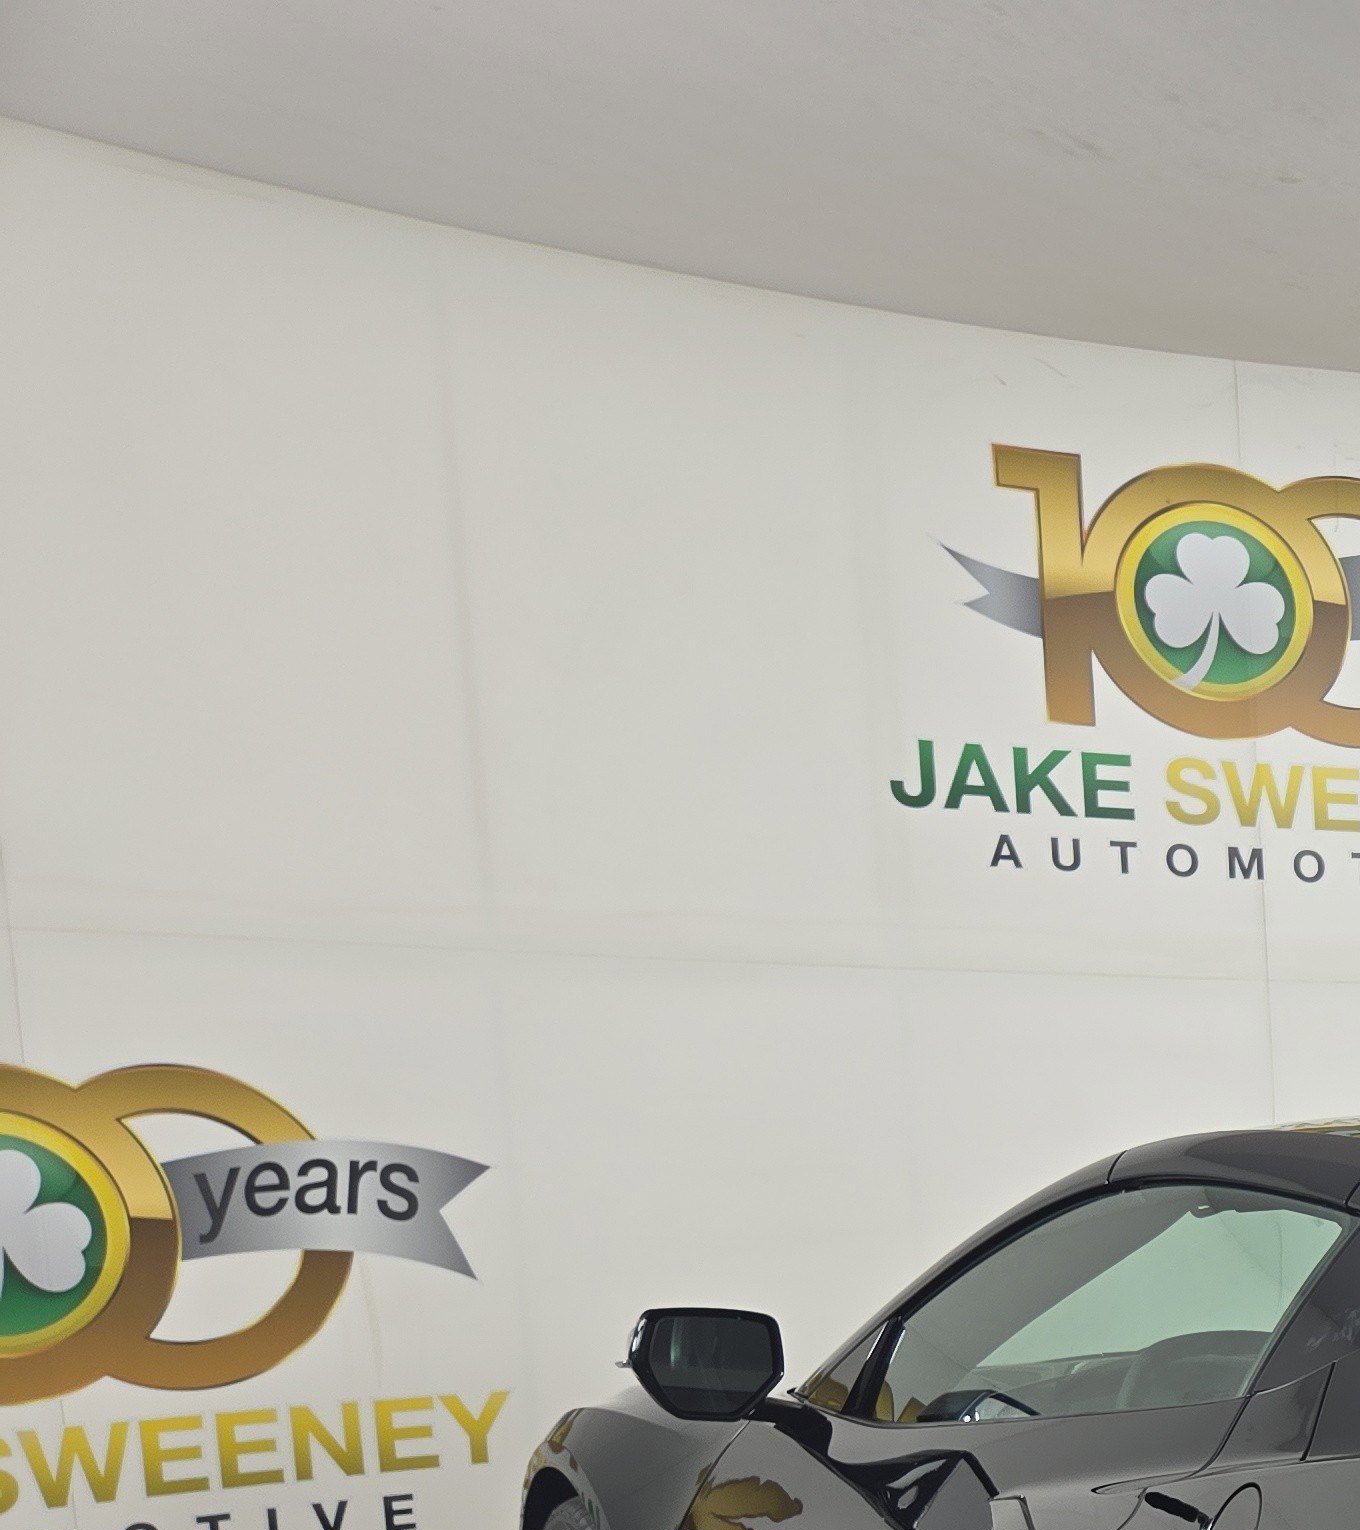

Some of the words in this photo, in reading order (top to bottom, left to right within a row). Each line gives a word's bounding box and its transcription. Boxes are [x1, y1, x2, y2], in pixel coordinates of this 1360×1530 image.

[890, 739, 1136, 820] JAKE
[194, 1158, 419, 1243] years
[0, 1391, 510, 1515] WEENEY
